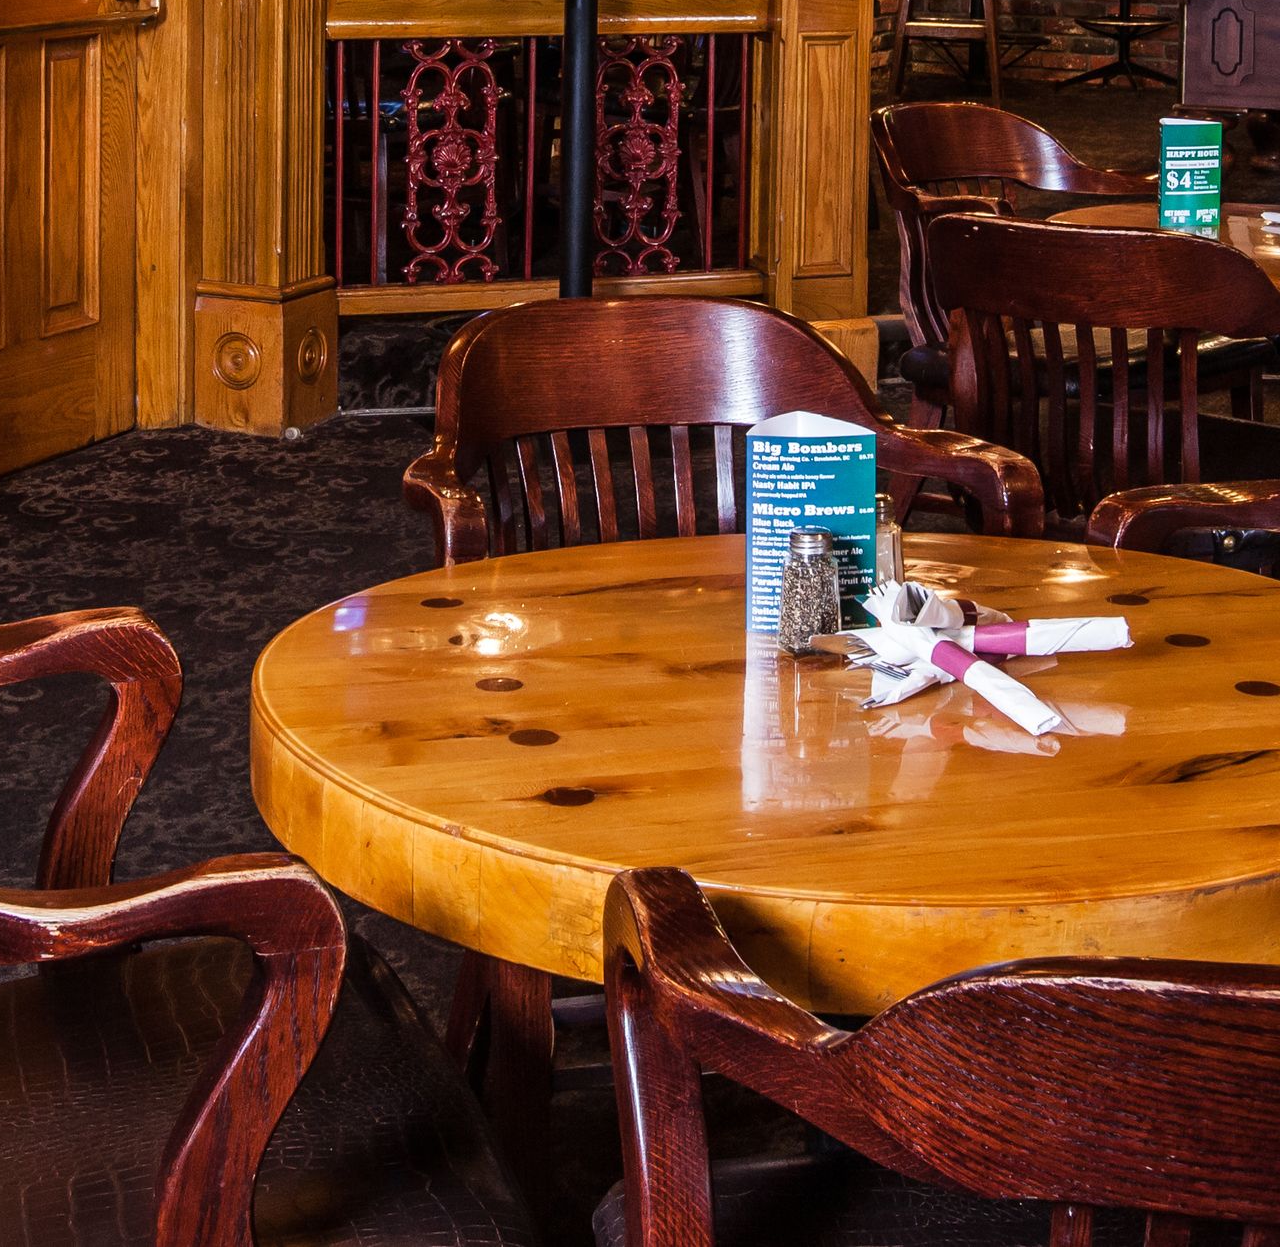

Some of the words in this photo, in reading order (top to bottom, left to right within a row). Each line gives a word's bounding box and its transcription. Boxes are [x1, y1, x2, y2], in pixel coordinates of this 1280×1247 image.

[1167, 170, 1191, 190] $4
[753, 441, 782, 456] Big
[788, 442, 862, 454] Bombers
[753, 462, 780, 470] Cream
[753, 480, 775, 490] Nasty
[777, 481, 799, 489] Habit
[753, 503, 801, 516] Micro
[804, 505, 854, 516] Brews
[753, 518, 771, 526] Blue
[774, 519, 794, 527] Buck
[752, 548, 788, 556] Beachco
[861, 576, 872, 584] Ale
[752, 607, 779, 615] Switch
